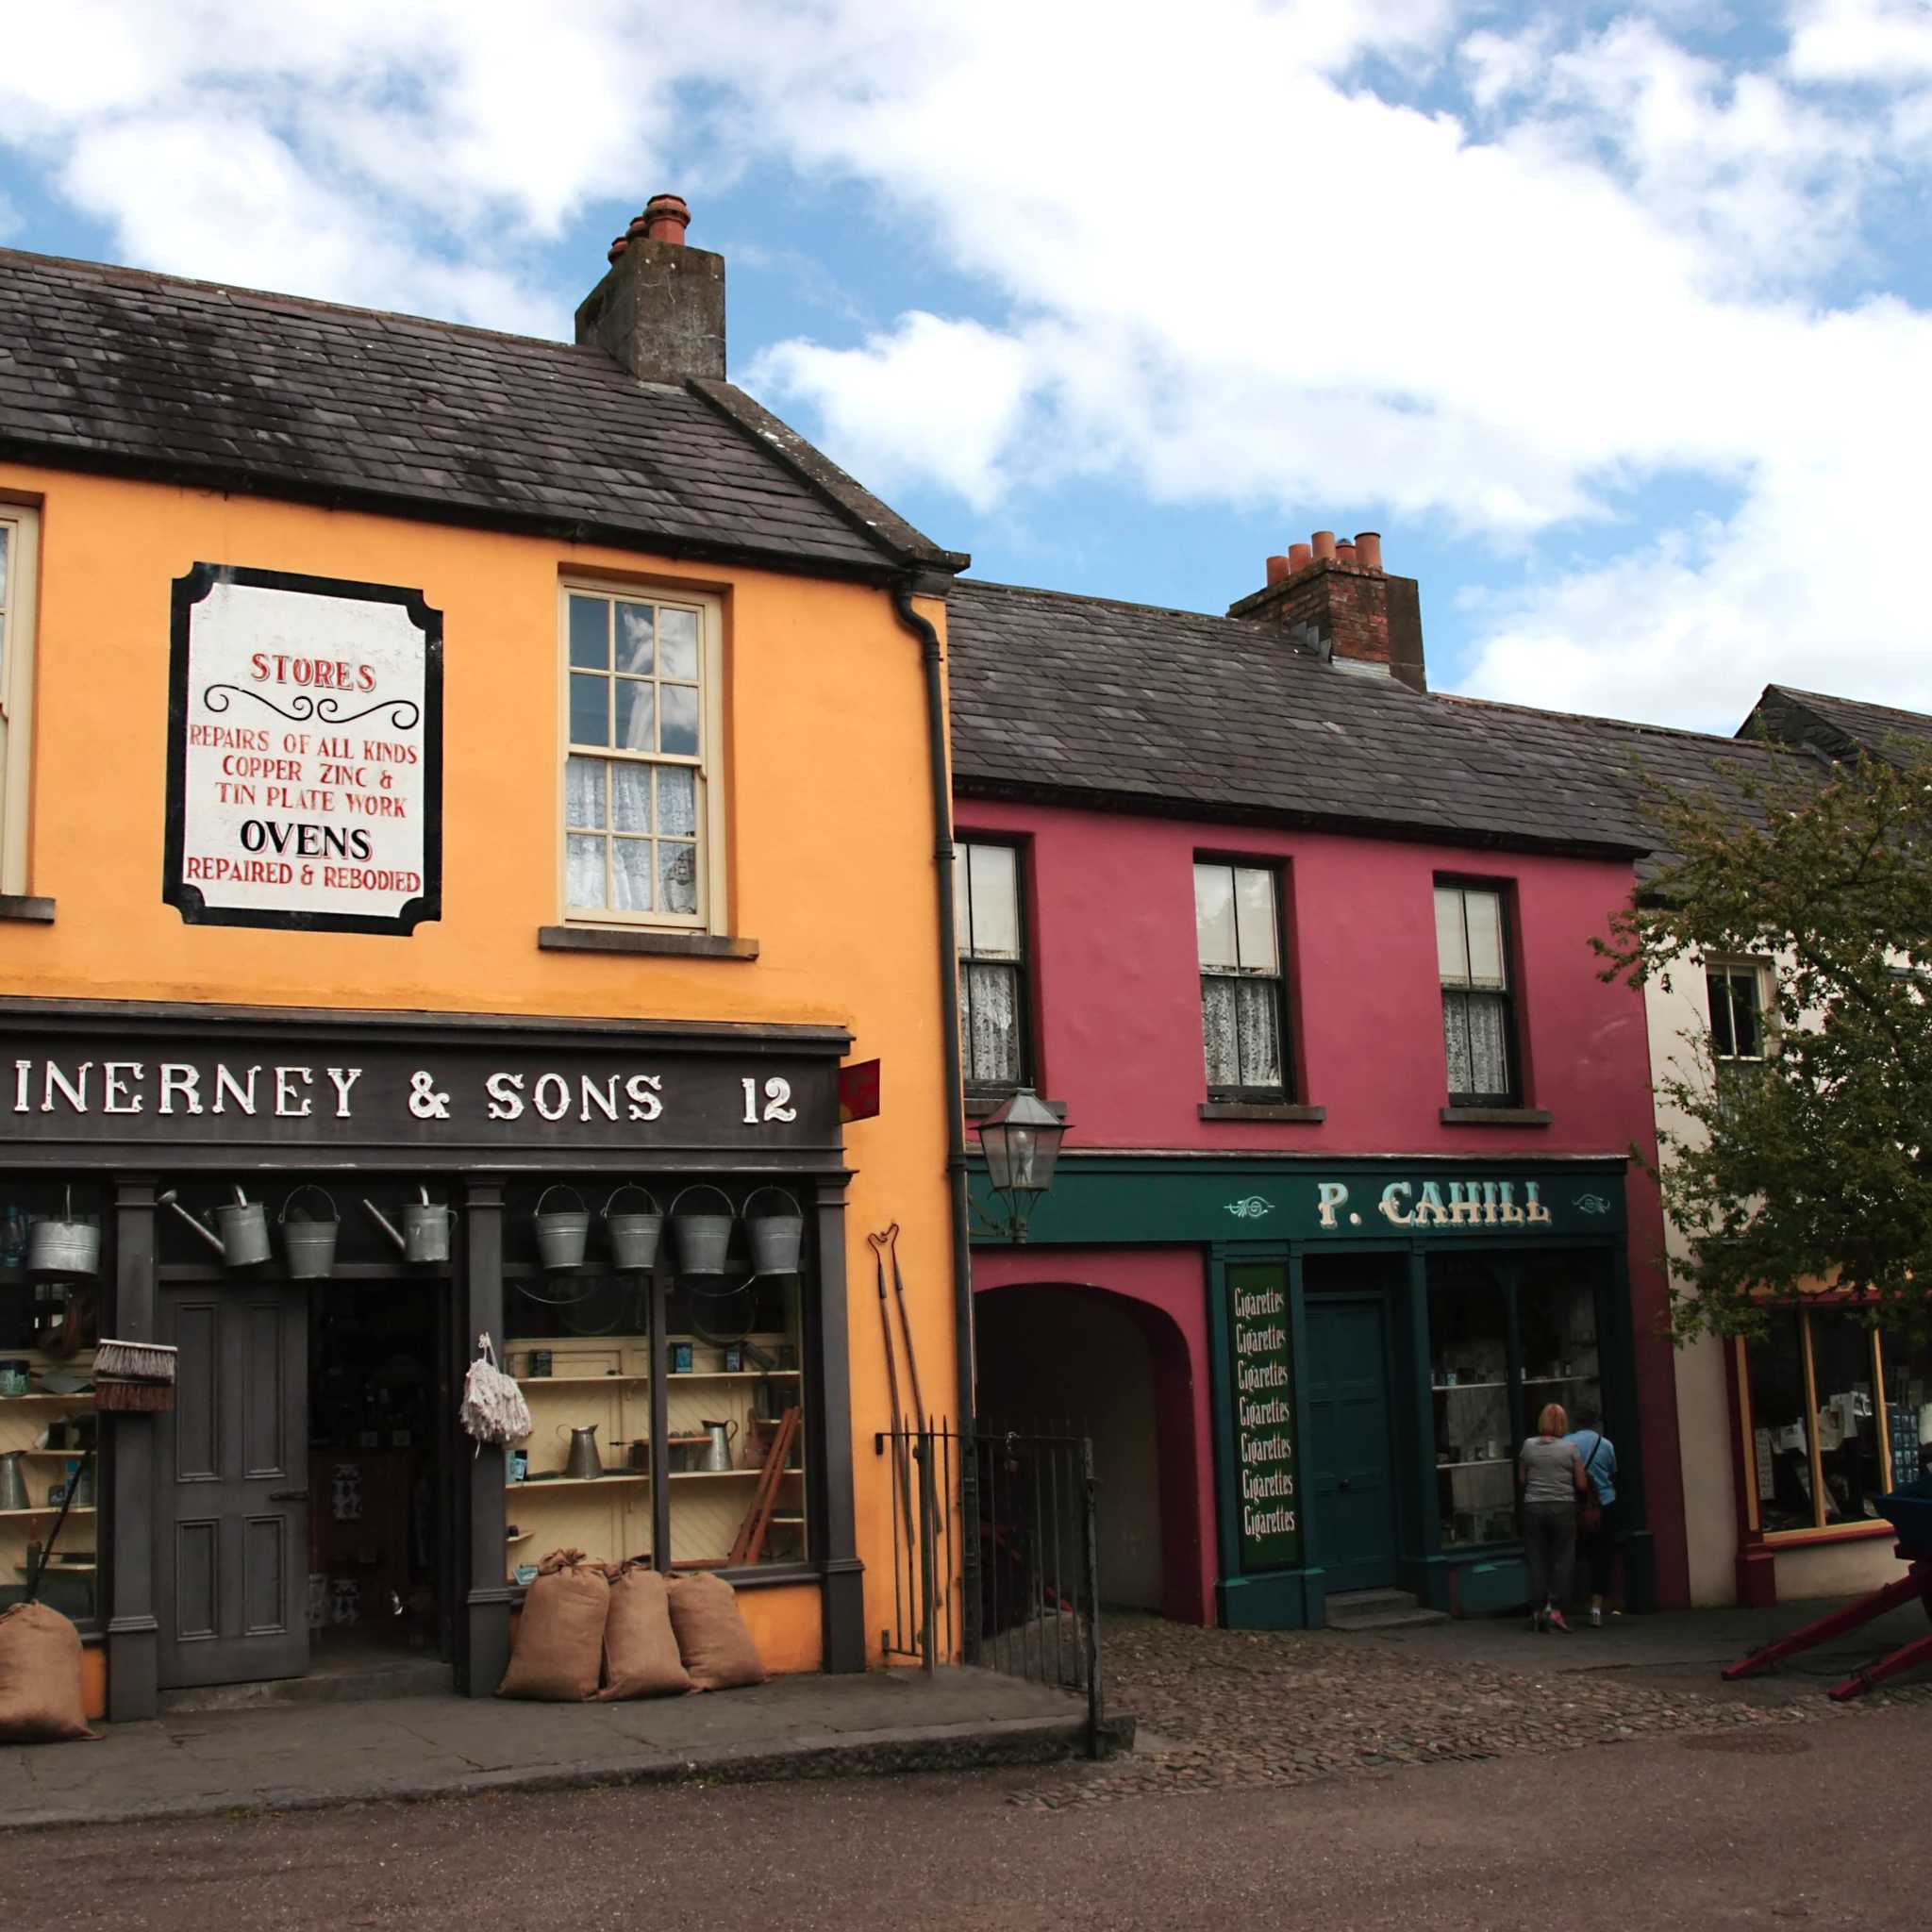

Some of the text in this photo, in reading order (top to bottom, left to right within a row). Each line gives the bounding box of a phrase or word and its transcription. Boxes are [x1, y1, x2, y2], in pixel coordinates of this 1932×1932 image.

[252, 654, 375, 691] STORES
[190, 724, 418, 764] REPAIRS OF ALL KINDS
[223, 755, 393, 791] COPPER ZINC &
[216, 782, 407, 819] TIN PLATE WORK
[240, 819, 372, 861] OVENS
[187, 857, 421, 892] REPAIRED & REBODIED
[13, 1059, 797, 1124] INERNEY & SONS 12
[1318, 1181, 1551, 1227] P. CAHILL
[1234, 1287, 1284, 1320] Cigarettes
[1236, 1324, 1286, 1357] Cigarettes
[1238, 1359, 1289, 1392] Cigarettes
[1240, 1396, 1290, 1429] Cigarettes
[1241, 1432, 1291, 1464] Cigarettes
[1242, 1469, 1293, 1504] Cigarettes
[1244, 1505, 1295, 1541] Cigarettes
